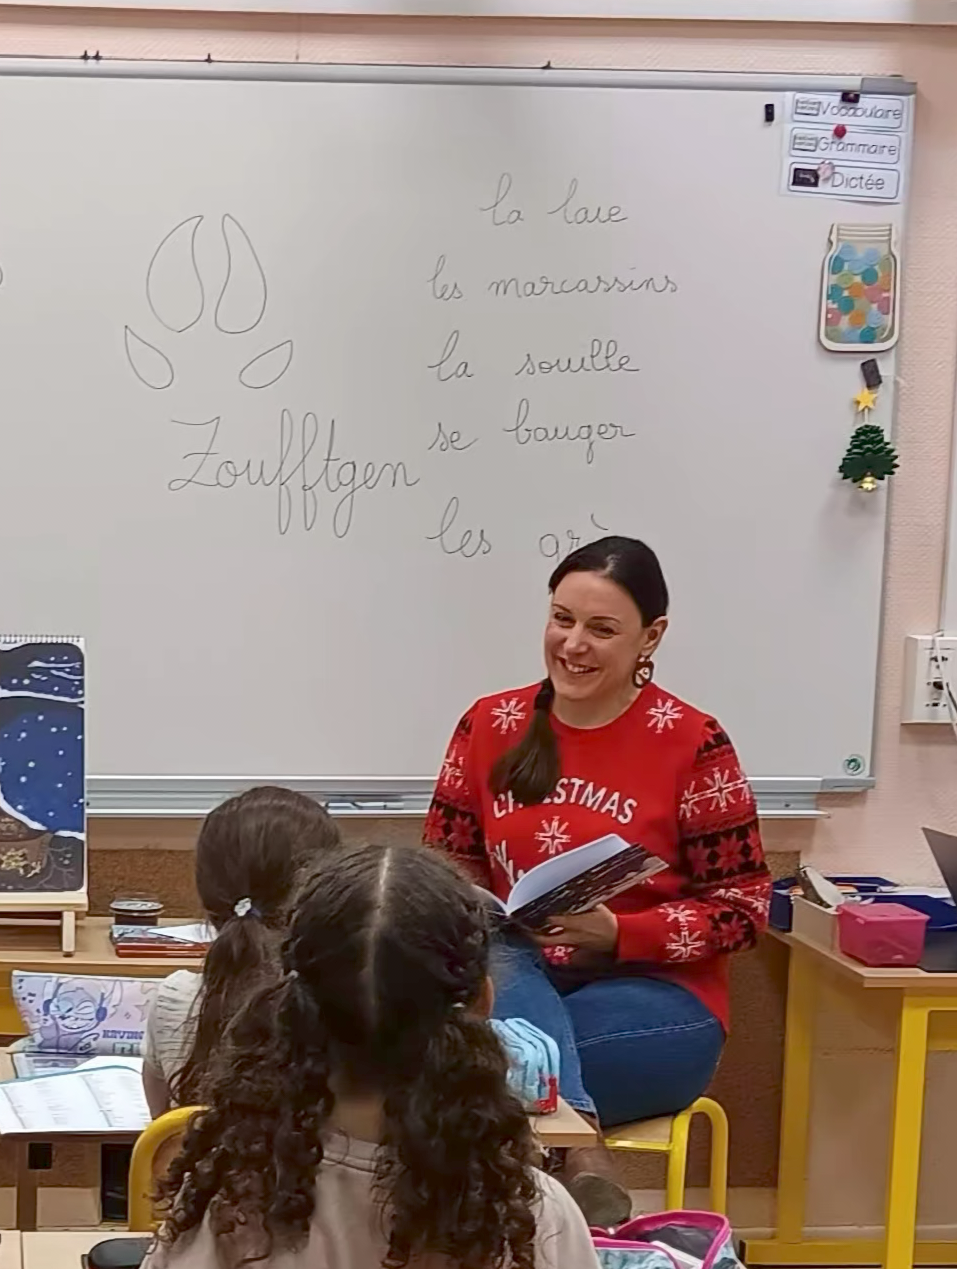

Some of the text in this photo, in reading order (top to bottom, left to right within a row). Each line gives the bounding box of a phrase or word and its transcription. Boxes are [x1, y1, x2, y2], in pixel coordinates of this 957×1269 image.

[479, 172, 628, 225] la laie
[831, 172, 885, 190] Dictée
[427, 254, 678, 301] les marcassins
[428, 330, 640, 381] la souille
[428, 398, 635, 464] se bauger
[168, 408, 420, 538] Zoufftgen
[426, 497, 492, 558] les
